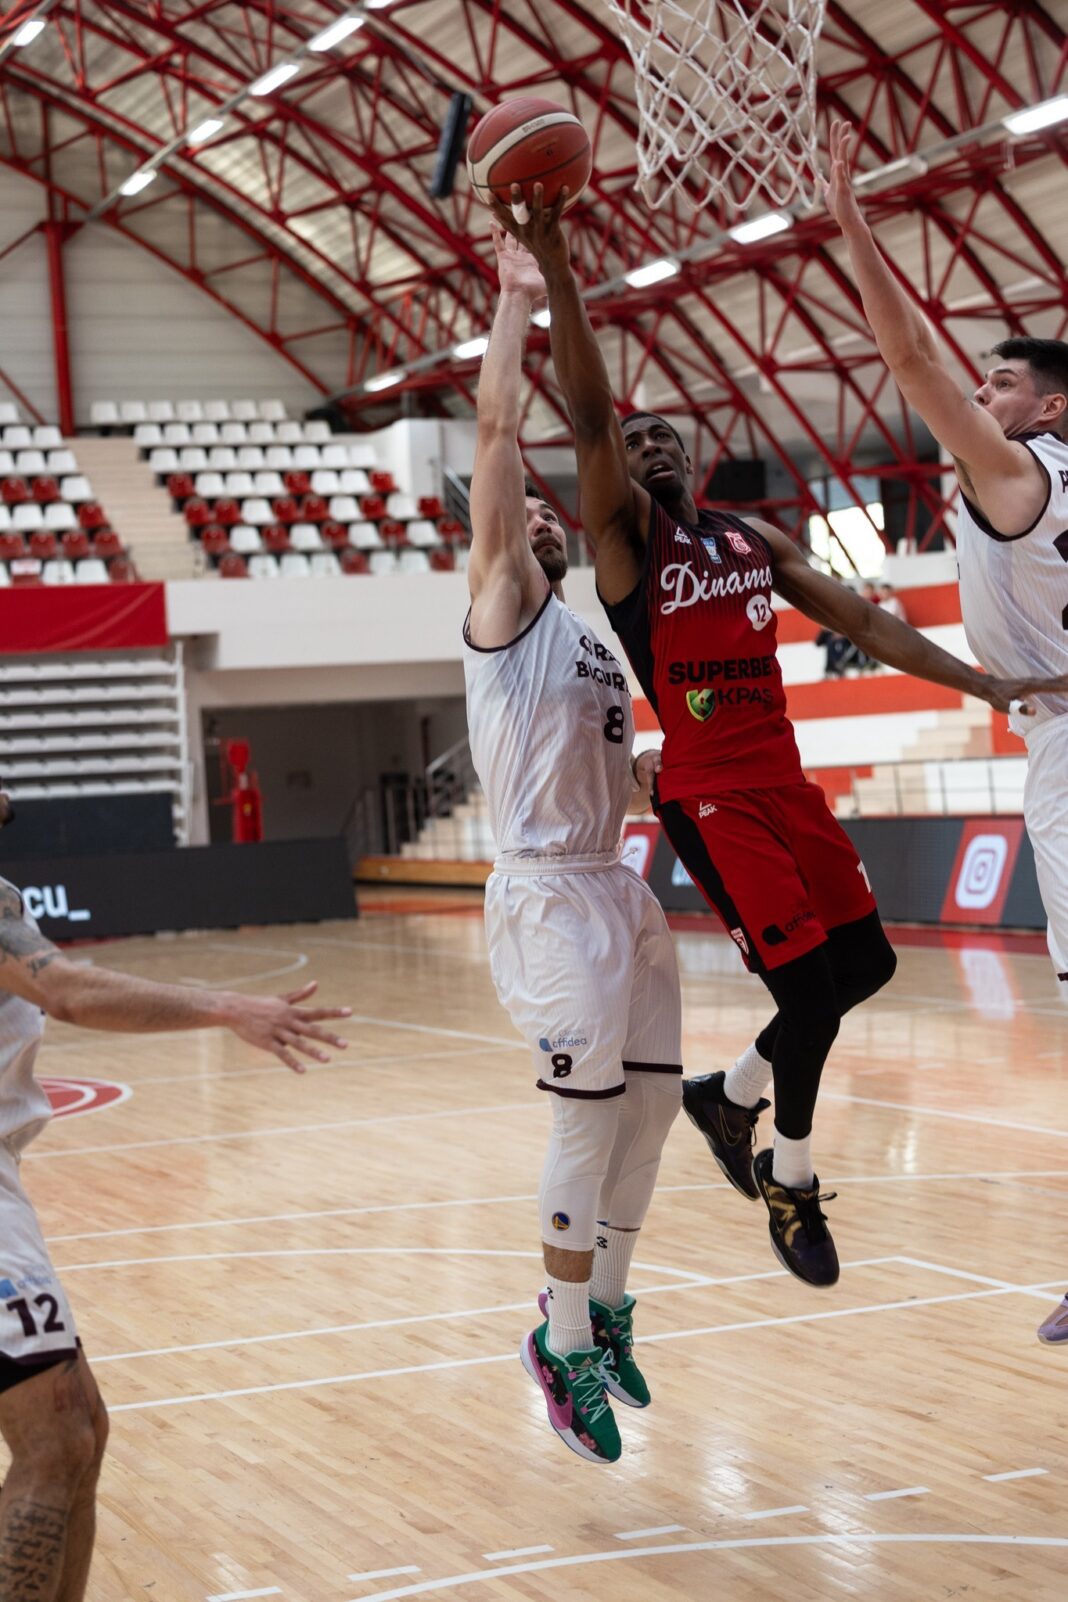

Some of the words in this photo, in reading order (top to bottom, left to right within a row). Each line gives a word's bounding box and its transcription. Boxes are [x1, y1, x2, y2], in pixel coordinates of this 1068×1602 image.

[660, 560, 773, 615] Dinamo
[753, 603, 767, 622] 12
[603, 705, 624, 744] 8
[551, 1053, 573, 1079] 8
[6, 1292, 66, 1338] 12
